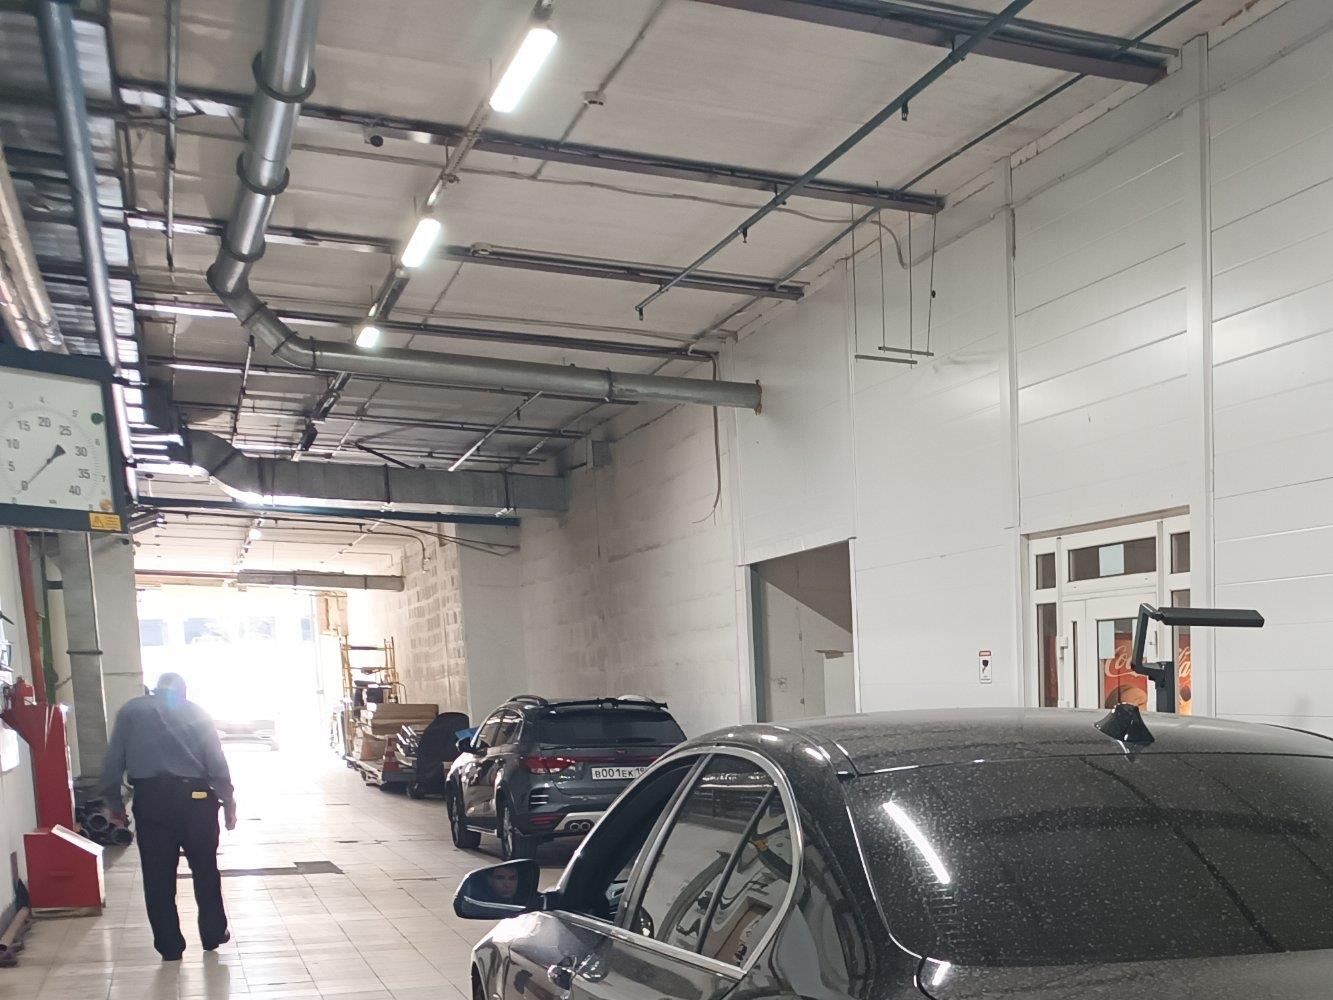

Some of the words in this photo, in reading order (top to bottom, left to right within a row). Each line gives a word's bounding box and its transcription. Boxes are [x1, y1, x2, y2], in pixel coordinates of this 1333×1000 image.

[18, 420, 31, 432] 15
[38, 416, 51, 428] 20
[59, 425, 72, 436] 25
[6, 439, 20, 449] 10
[75, 446, 88, 456] 30
[8, 461, 15, 472] 5
[78, 469, 91, 479] 35
[21, 480, 28, 491] 0
[69, 485, 81, 496] 40
